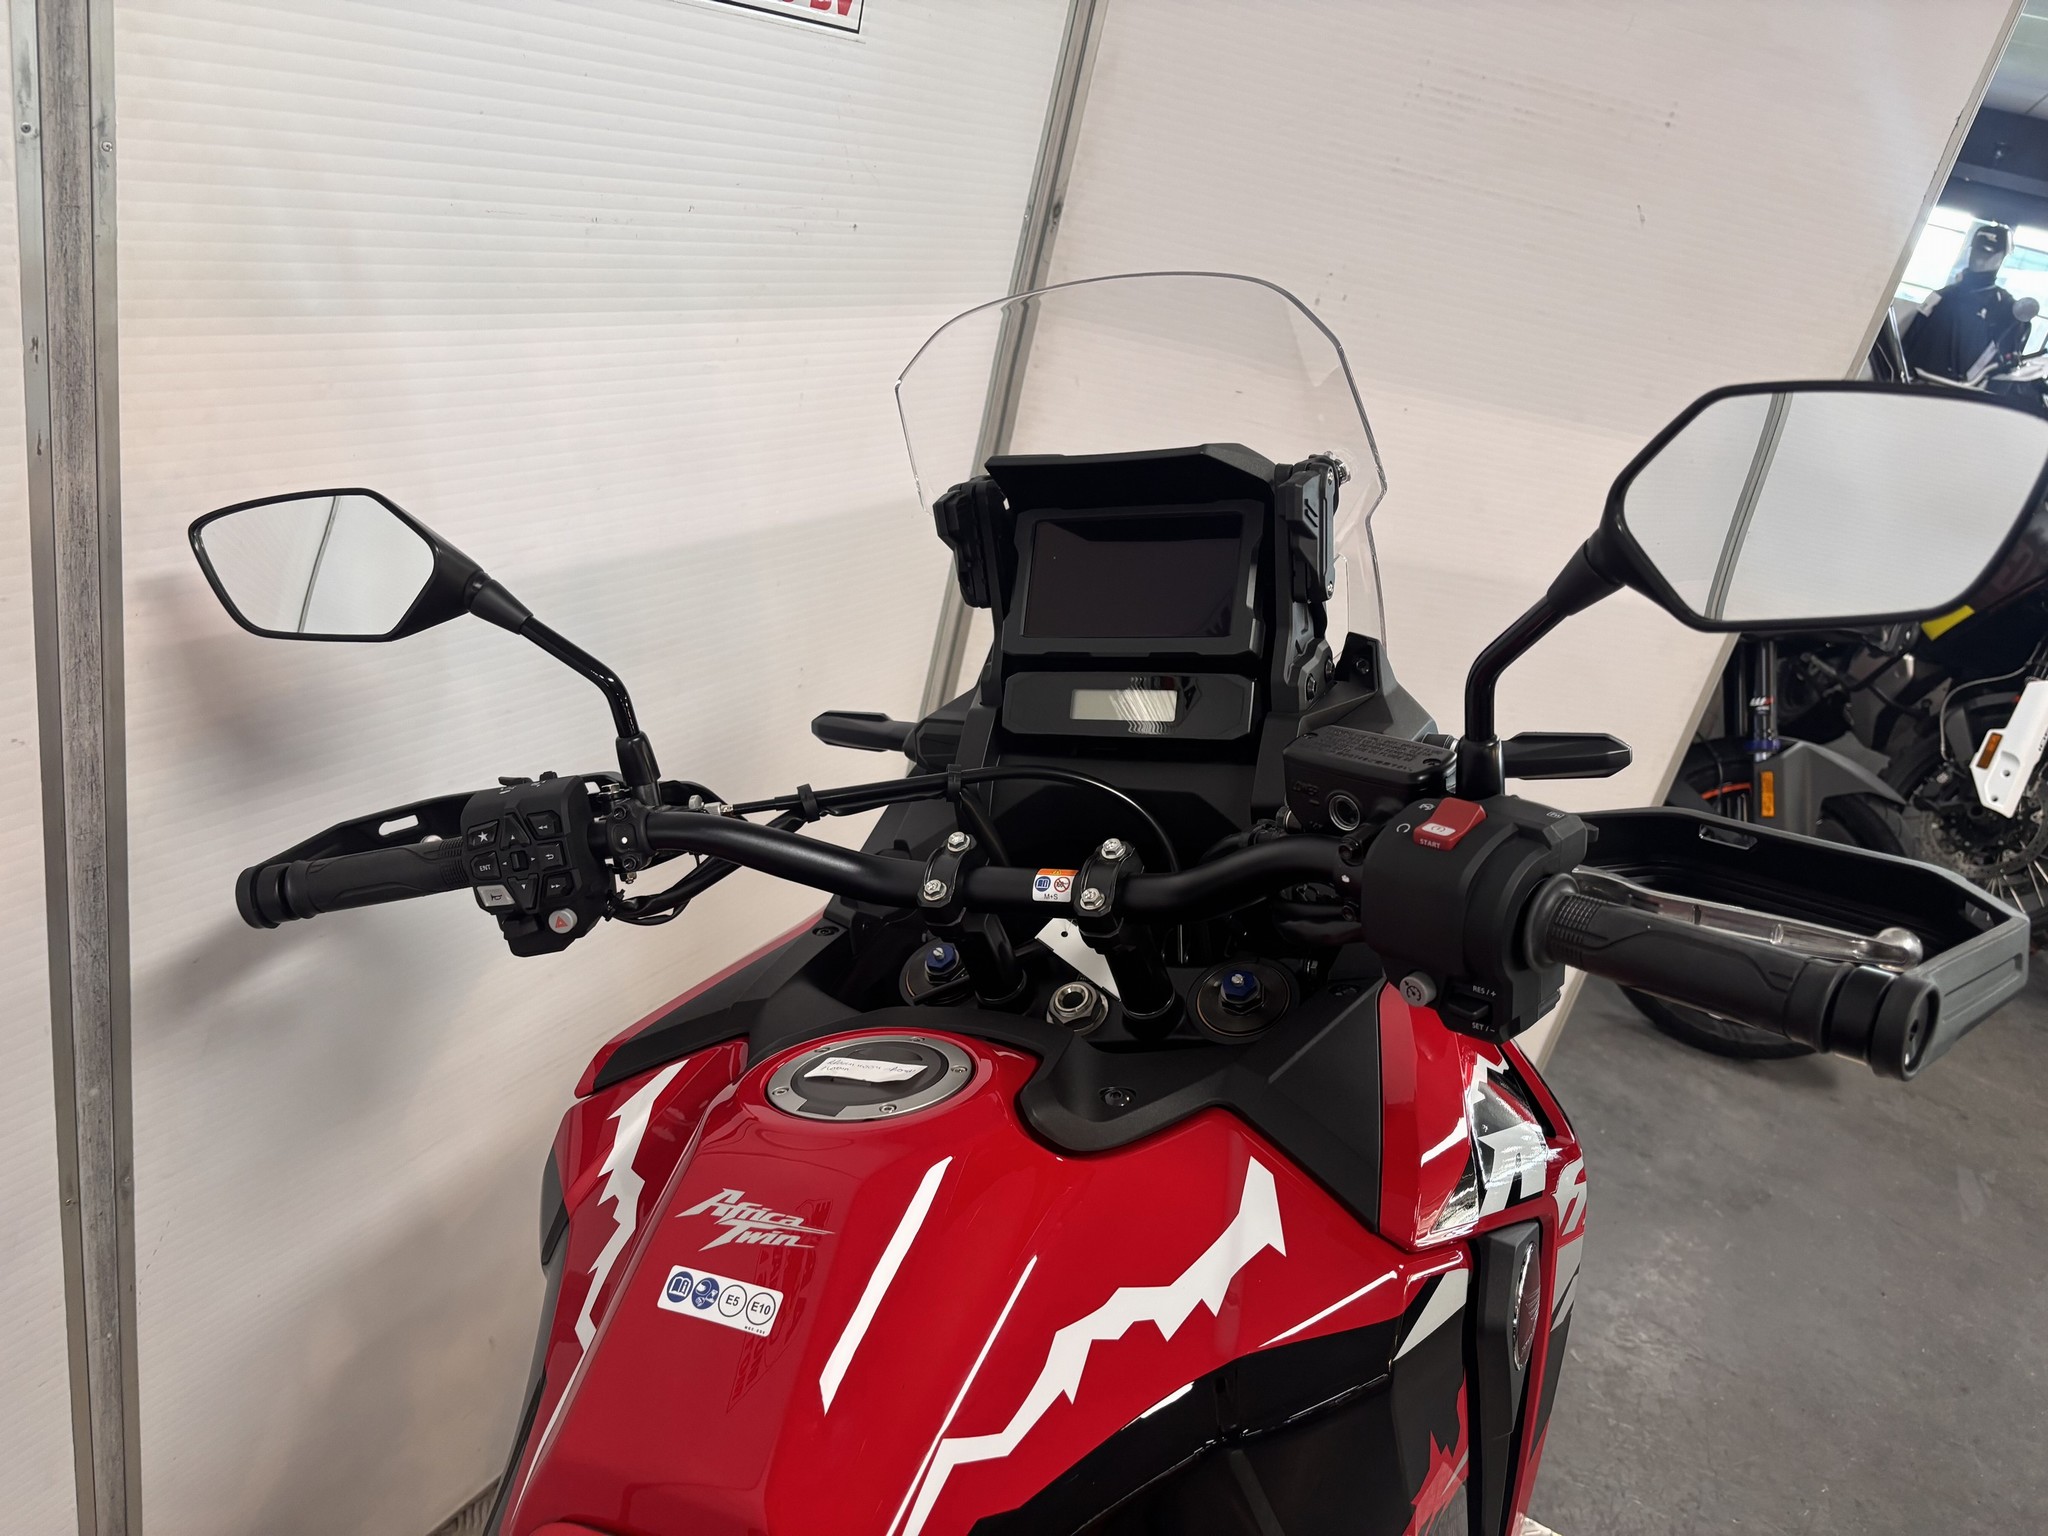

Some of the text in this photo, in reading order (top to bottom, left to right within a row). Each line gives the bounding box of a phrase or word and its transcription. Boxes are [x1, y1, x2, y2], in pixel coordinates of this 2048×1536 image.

[1419, 838, 1441, 849] START
[1472, 985, 1485, 995] RES
[1471, 1021, 1484, 1031] SET
[675, 1188, 804, 1225] Africa
[698, 1218, 835, 1252] Twin
[726, 1294, 740, 1307] E5
[750, 1301, 771, 1315] E10
